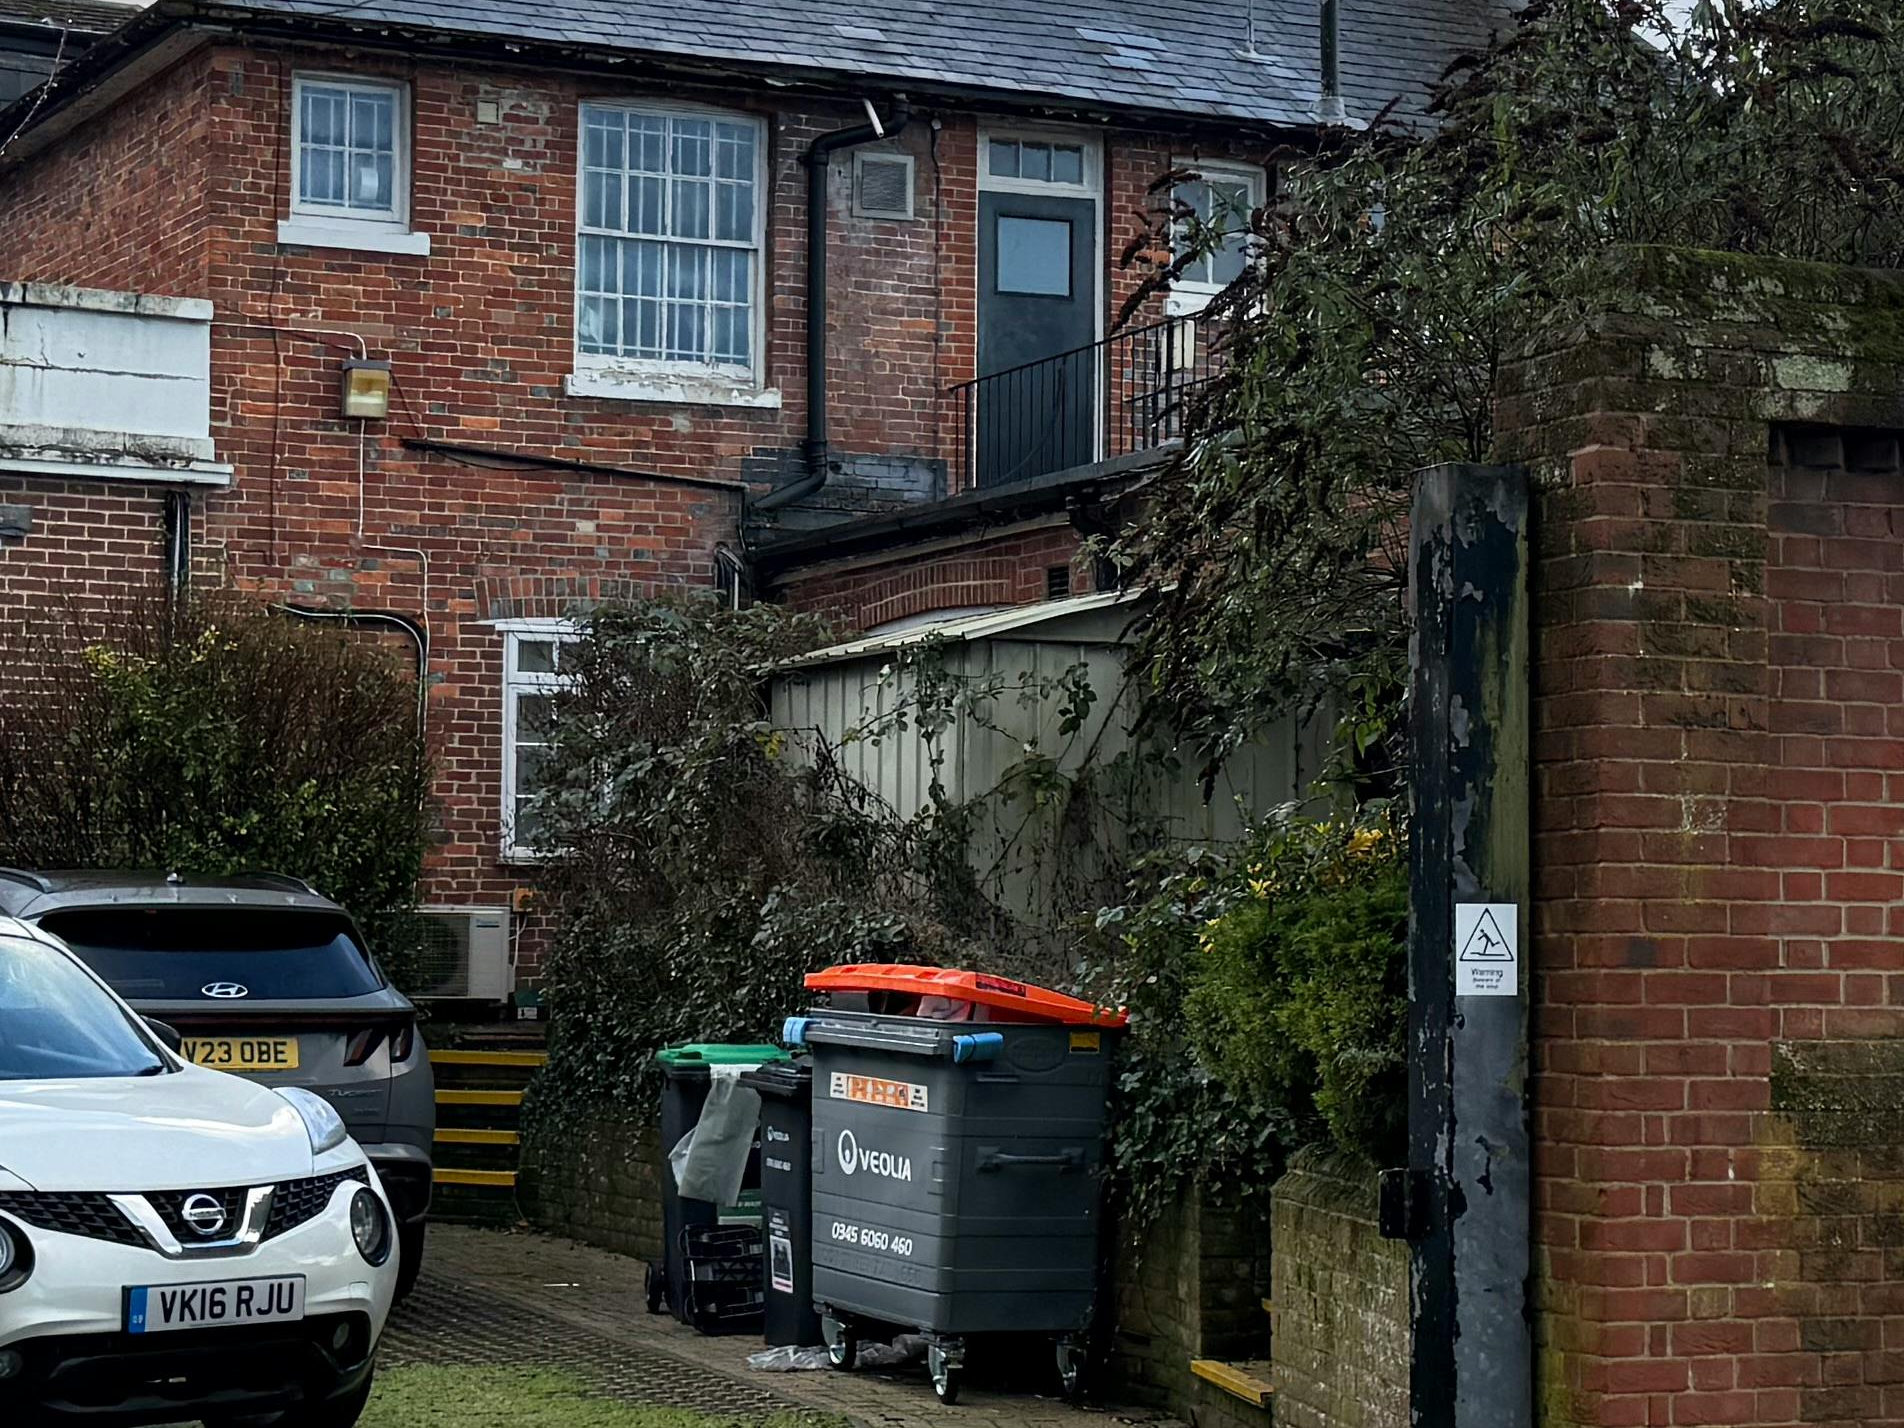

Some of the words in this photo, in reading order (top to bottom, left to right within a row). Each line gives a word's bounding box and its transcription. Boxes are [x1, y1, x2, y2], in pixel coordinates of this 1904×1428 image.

[182, 1041, 233, 1063] V23
[240, 1041, 288, 1063] OBE
[858, 1147, 912, 1182] VEOLIA
[831, 1222, 859, 1243] 0345
[860, 1228, 889, 1251] 6060
[890, 1235, 913, 1256] 460
[160, 1286, 227, 1324] VK16
[235, 1281, 295, 1318] RJU
